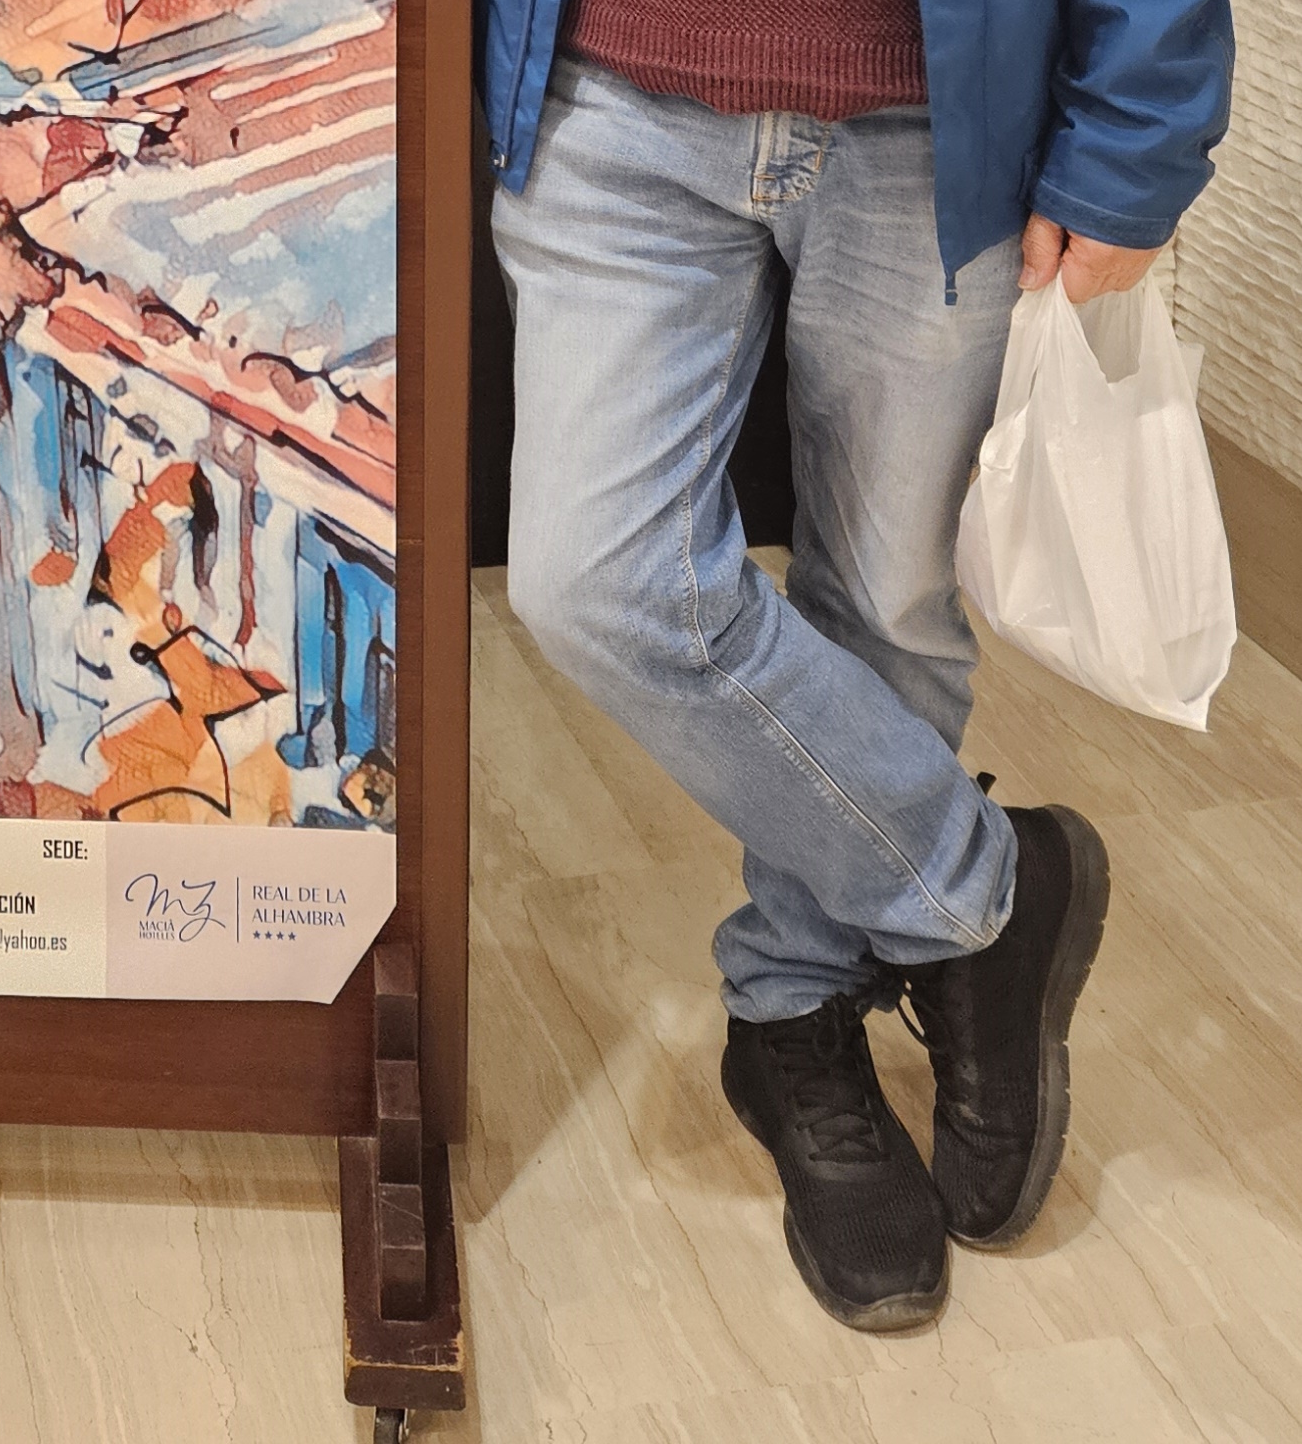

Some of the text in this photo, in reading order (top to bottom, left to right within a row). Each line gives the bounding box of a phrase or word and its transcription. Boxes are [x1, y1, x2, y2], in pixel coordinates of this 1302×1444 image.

[43, 839, 89, 860] SEDE:
[253, 885, 347, 905] REAL DE LA
[252, 908, 346, 927] ALHAMBRA
